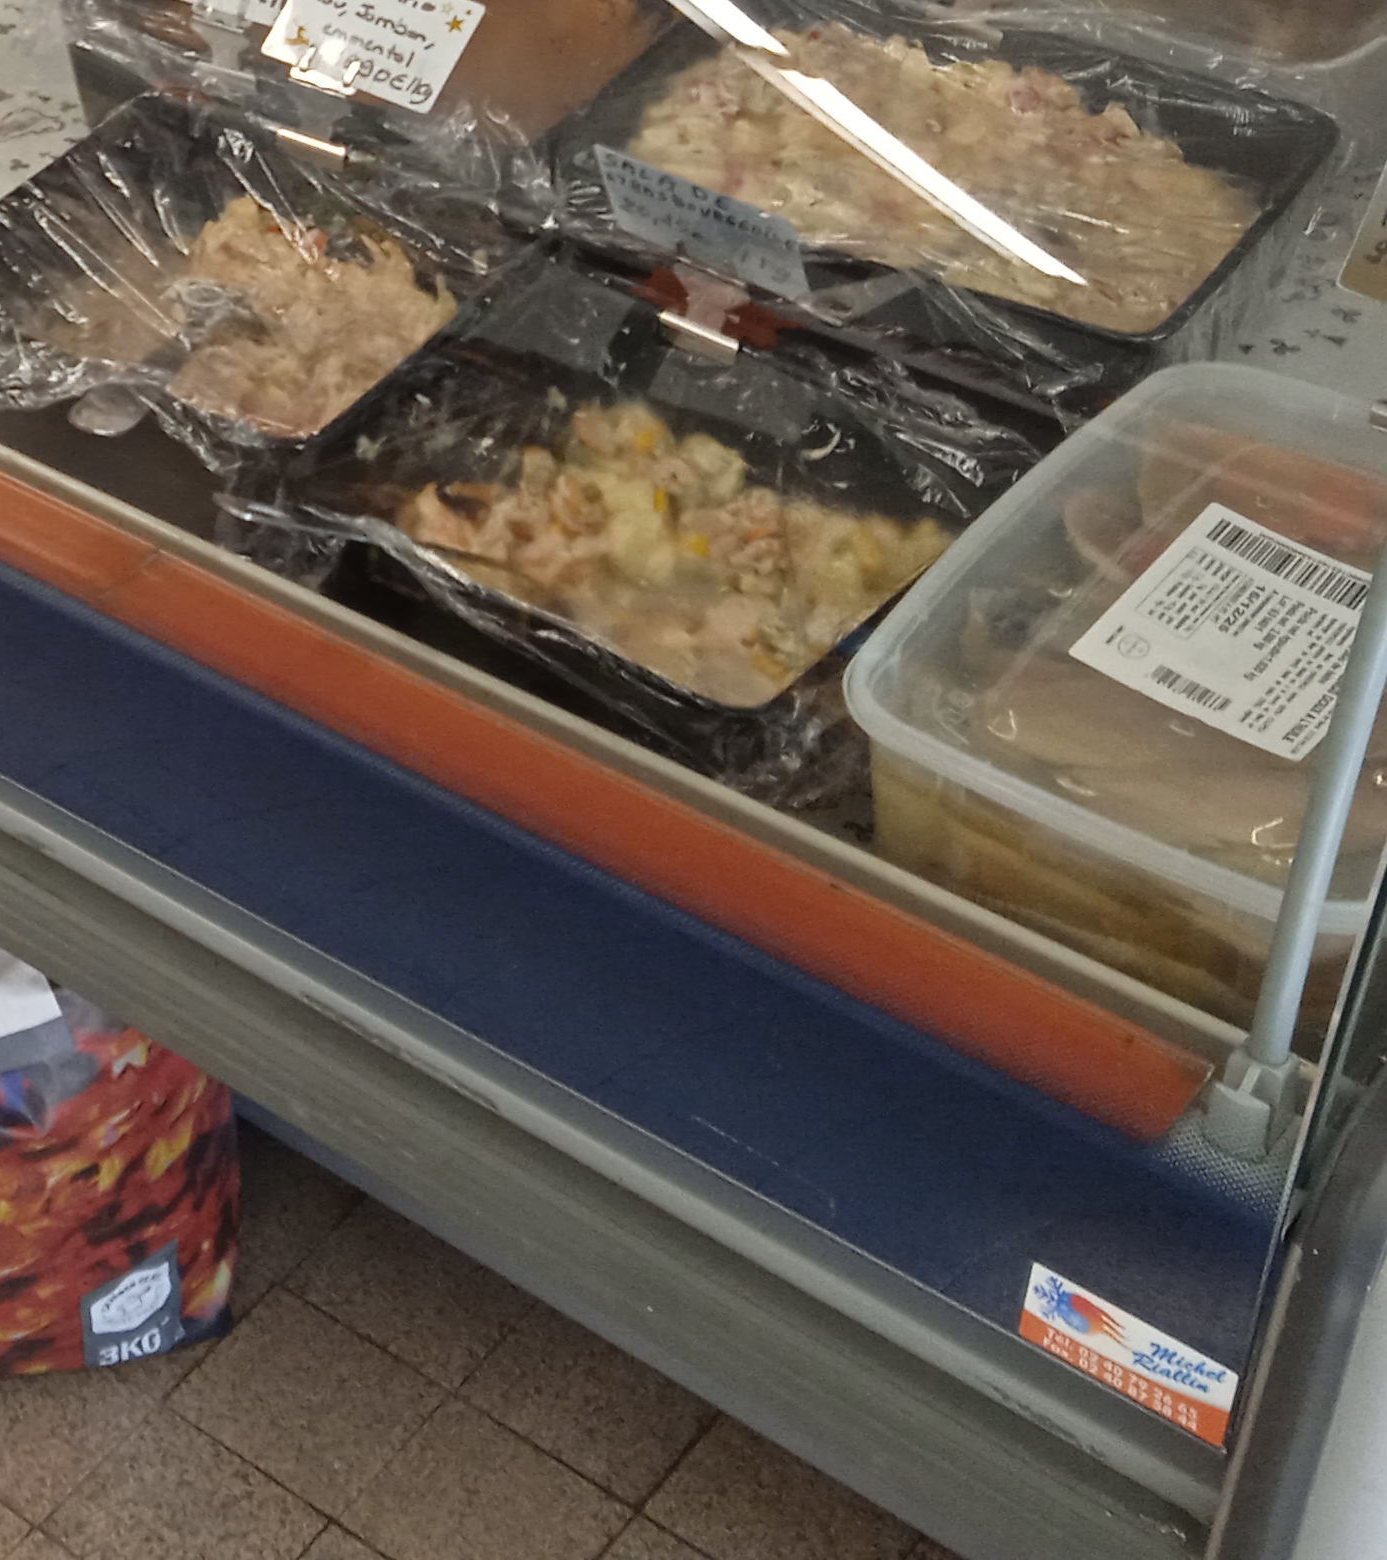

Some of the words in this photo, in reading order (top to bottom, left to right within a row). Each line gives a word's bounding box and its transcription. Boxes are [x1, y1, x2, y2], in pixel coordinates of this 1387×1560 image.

[97, 1330, 162, 1367] 3KG
[1150, 1341, 1228, 1384] Michel
[1132, 1350, 1210, 1394] Riallin
